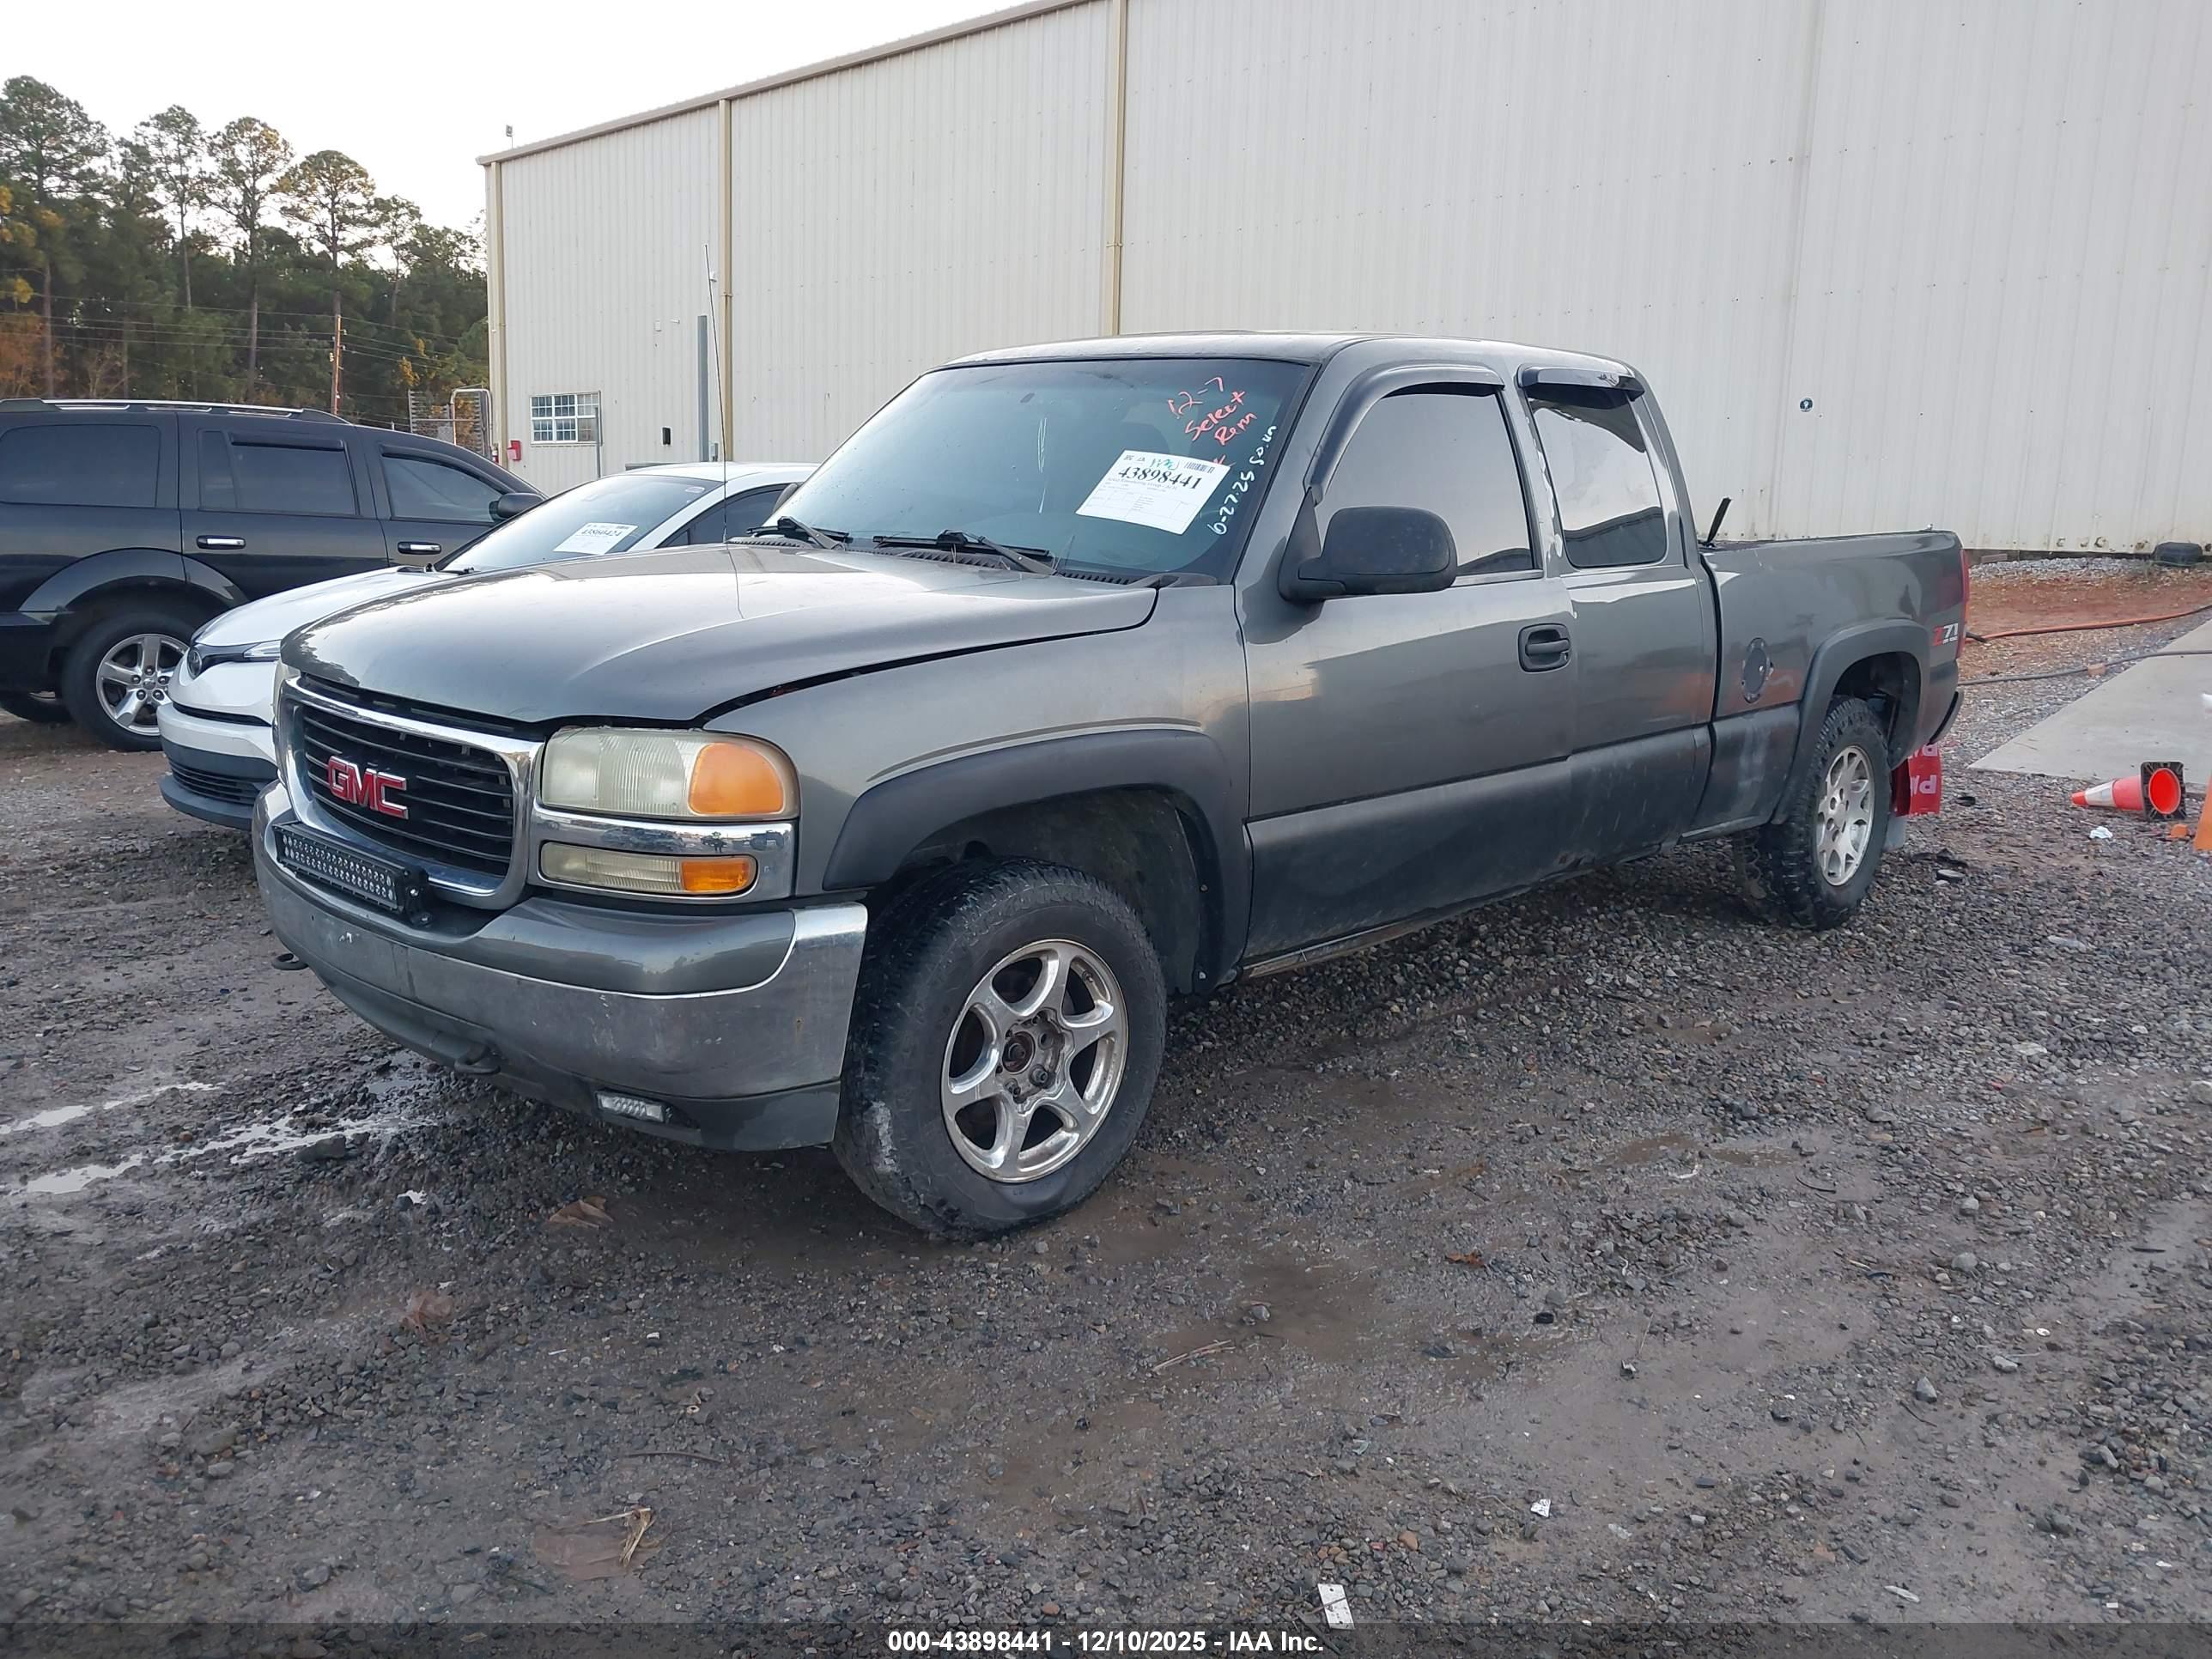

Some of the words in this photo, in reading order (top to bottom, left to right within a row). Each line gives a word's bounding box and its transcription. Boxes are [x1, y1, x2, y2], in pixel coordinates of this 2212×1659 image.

[1184, 391, 1245, 441] Select
[1118, 466, 1203, 489] 43898441
[1933, 623, 1959, 646] Z71
[328, 756, 409, 819] GMC
